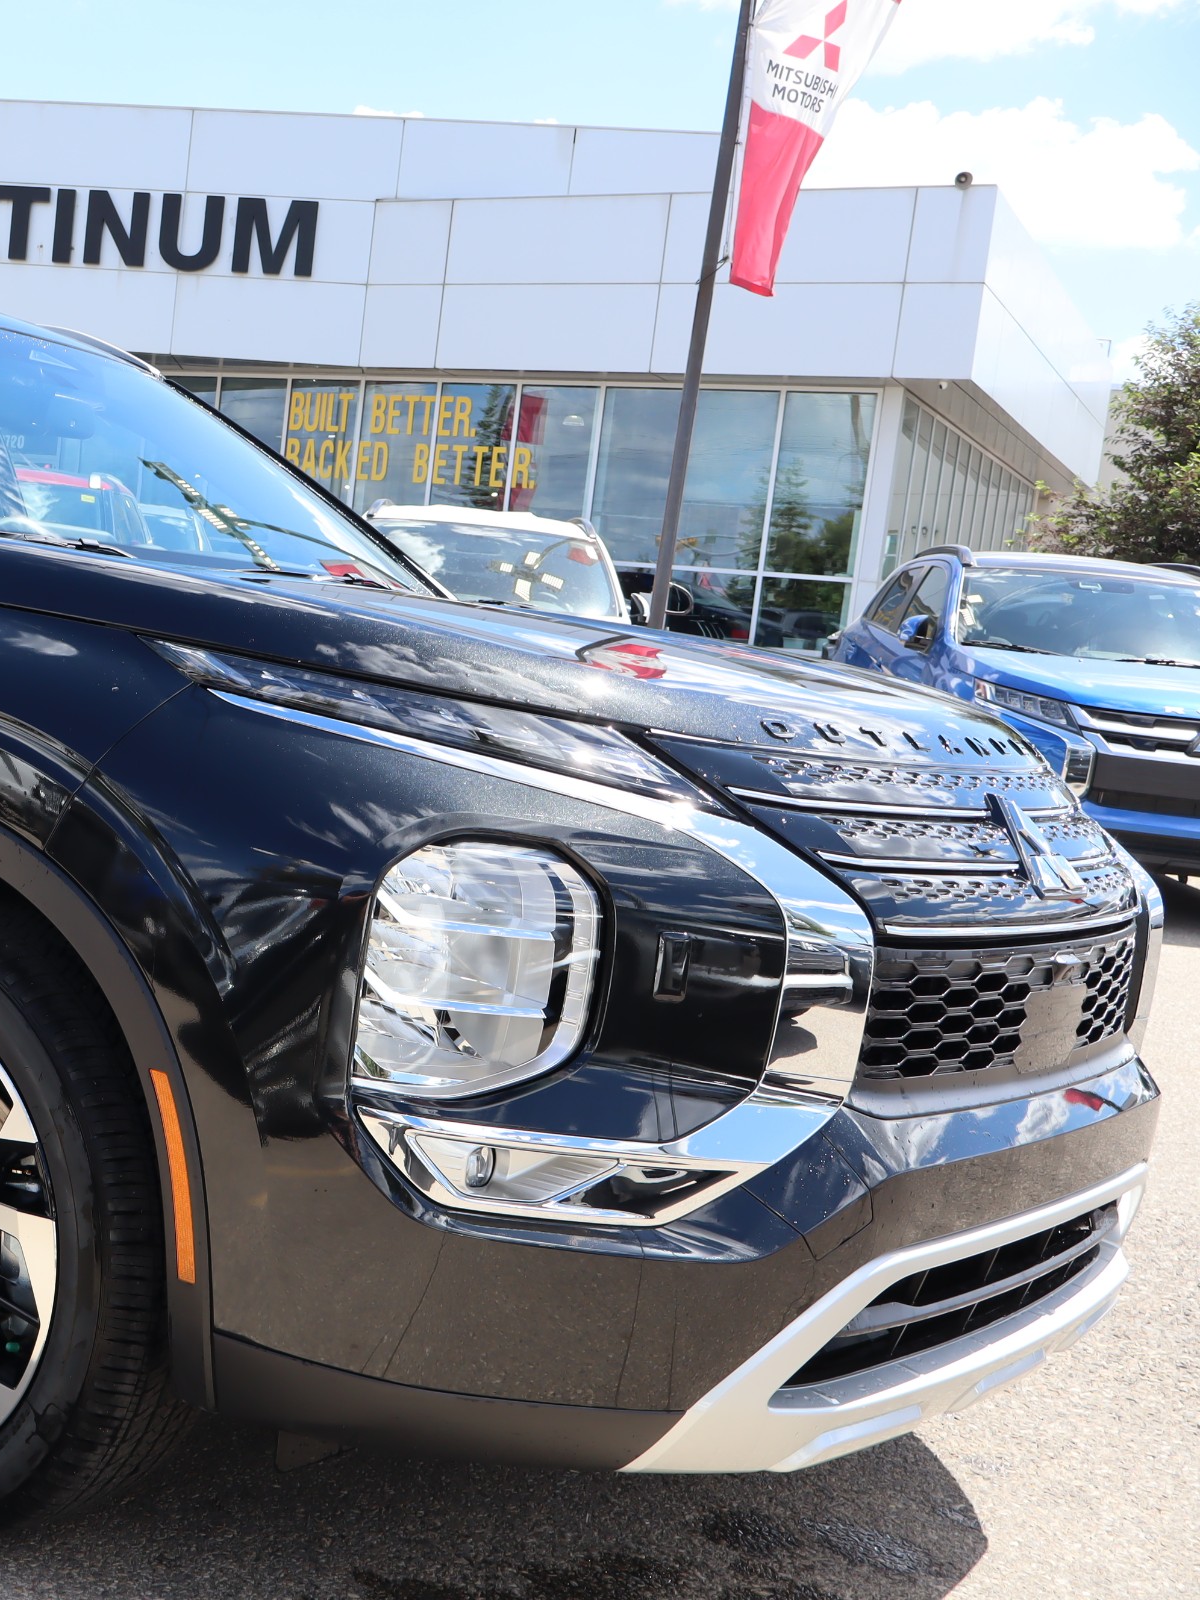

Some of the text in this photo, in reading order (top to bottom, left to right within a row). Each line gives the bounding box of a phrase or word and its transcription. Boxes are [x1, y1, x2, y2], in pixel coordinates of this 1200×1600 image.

[766, 58, 839, 100] MITSUBISHI
[771, 83, 824, 113] MOTORS
[288, 391, 477, 438] BUILT BETTER.
[286, 438, 537, 490] BACKED BETTER.
